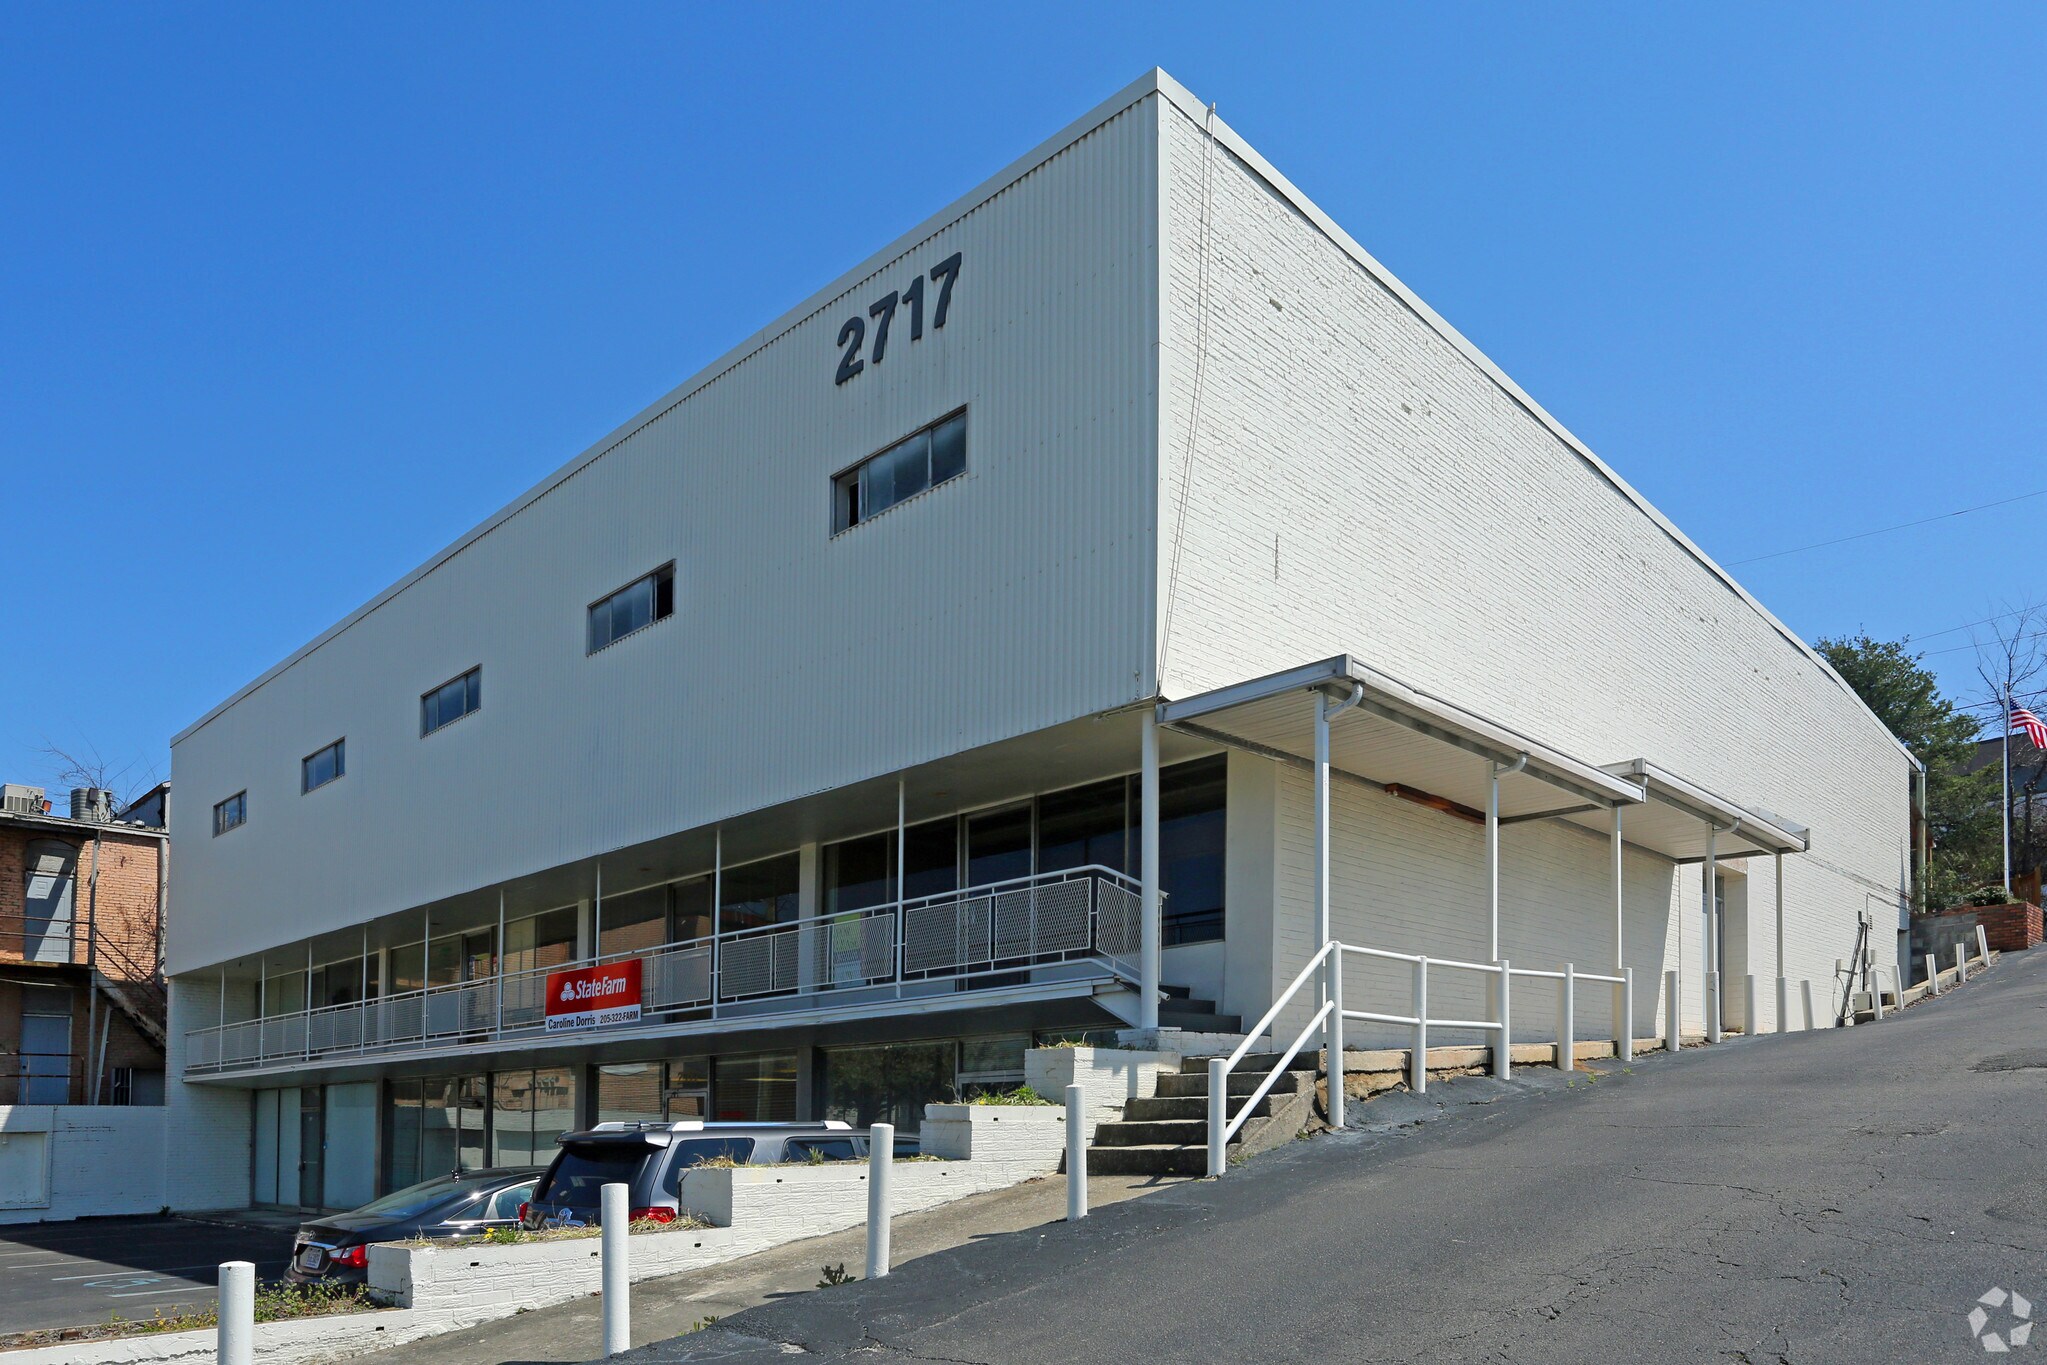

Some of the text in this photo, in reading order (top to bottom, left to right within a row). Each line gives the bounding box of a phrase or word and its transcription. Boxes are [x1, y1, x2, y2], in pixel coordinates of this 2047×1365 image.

[836, 252, 962, 386] 2717
[548, 1011, 638, 1029] Caroline Dorris 205-322-FARM
